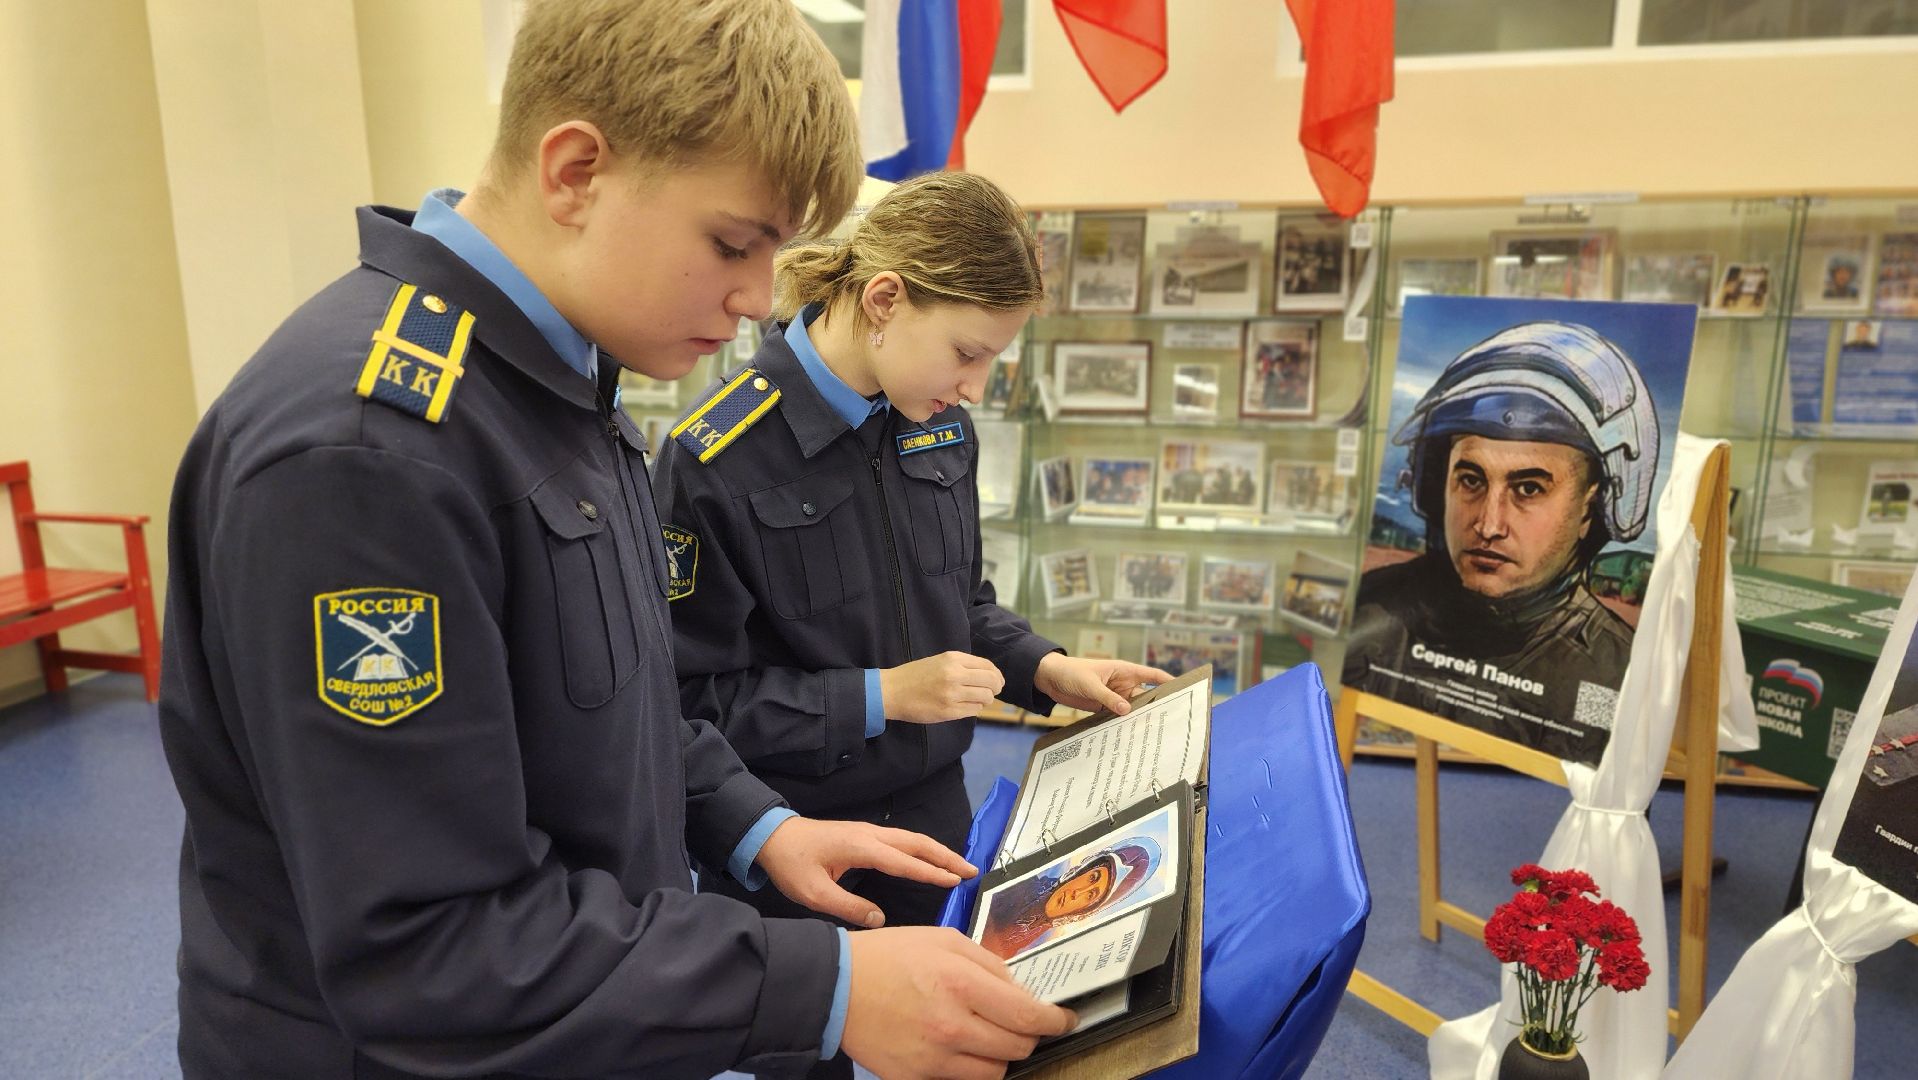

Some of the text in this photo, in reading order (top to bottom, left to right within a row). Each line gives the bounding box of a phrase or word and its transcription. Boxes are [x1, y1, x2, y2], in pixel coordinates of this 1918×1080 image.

[662, 530, 693, 545] ССИЯ
[328, 597, 426, 616] РОССИЯ
[1411, 643, 1477, 677] Сергей
[1482, 663, 1544, 696] Панов
[326, 671, 435, 698] СВЕРДЛОВСКАЯ
[349, 694, 414, 714] СОШ №2
[1759, 686, 1806, 709] ПРОЕКТ
[1757, 700, 1802, 723] НОВАЯ
[1755, 714, 1804, 739] ШКОЛА
[1875, 824, 1913, 850] Гвардии
